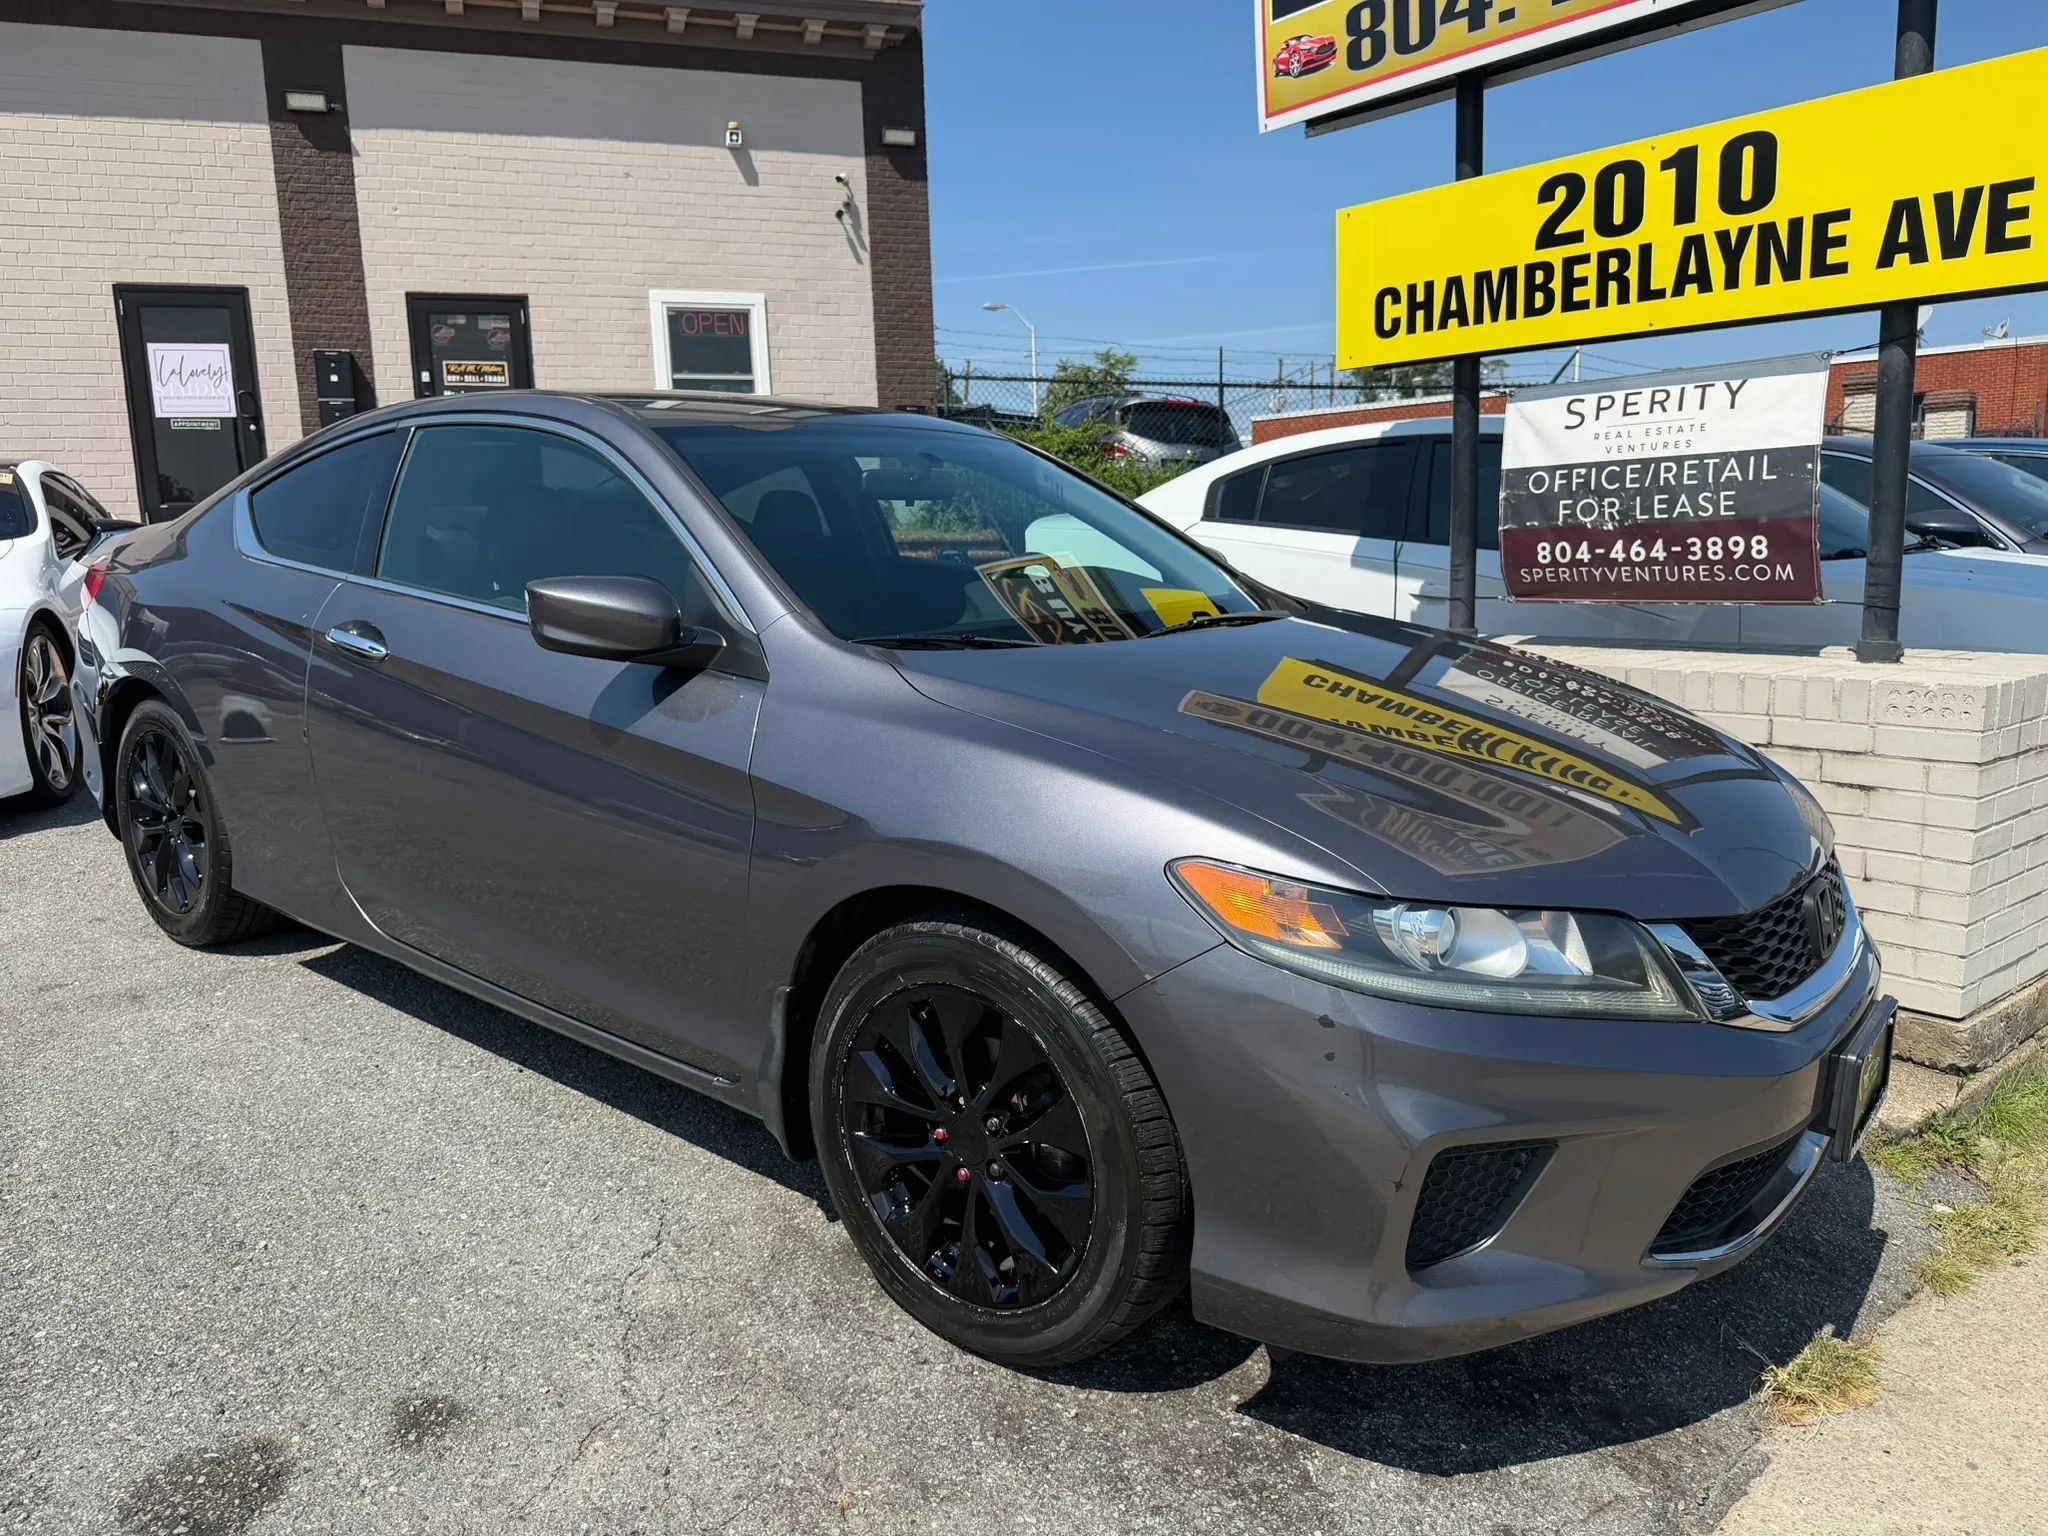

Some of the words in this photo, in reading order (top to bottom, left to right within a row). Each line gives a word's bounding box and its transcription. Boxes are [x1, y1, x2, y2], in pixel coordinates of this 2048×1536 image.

[1535, 130, 1778, 251] 2010
[1374, 207, 1851, 339] CHAMBERLAYNE
[1875, 176, 2036, 270] AVE
[681, 312, 745, 335] OPEN
[1564, 379, 1749, 430] SPERITY
[1593, 430, 1633, 441] REAL
[1645, 423, 1707, 437] ESTATE
[1605, 439, 1693, 454] VENTURES
[1528, 455, 1778, 494] OFFICE/RETAIL
[1558, 498, 1620, 523] FOR
[1635, 491, 1736, 518] LEASE
[1536, 534, 1769, 564] 804-464-3898
[1520, 563, 1795, 583] SPERITYVENTURES.COM
